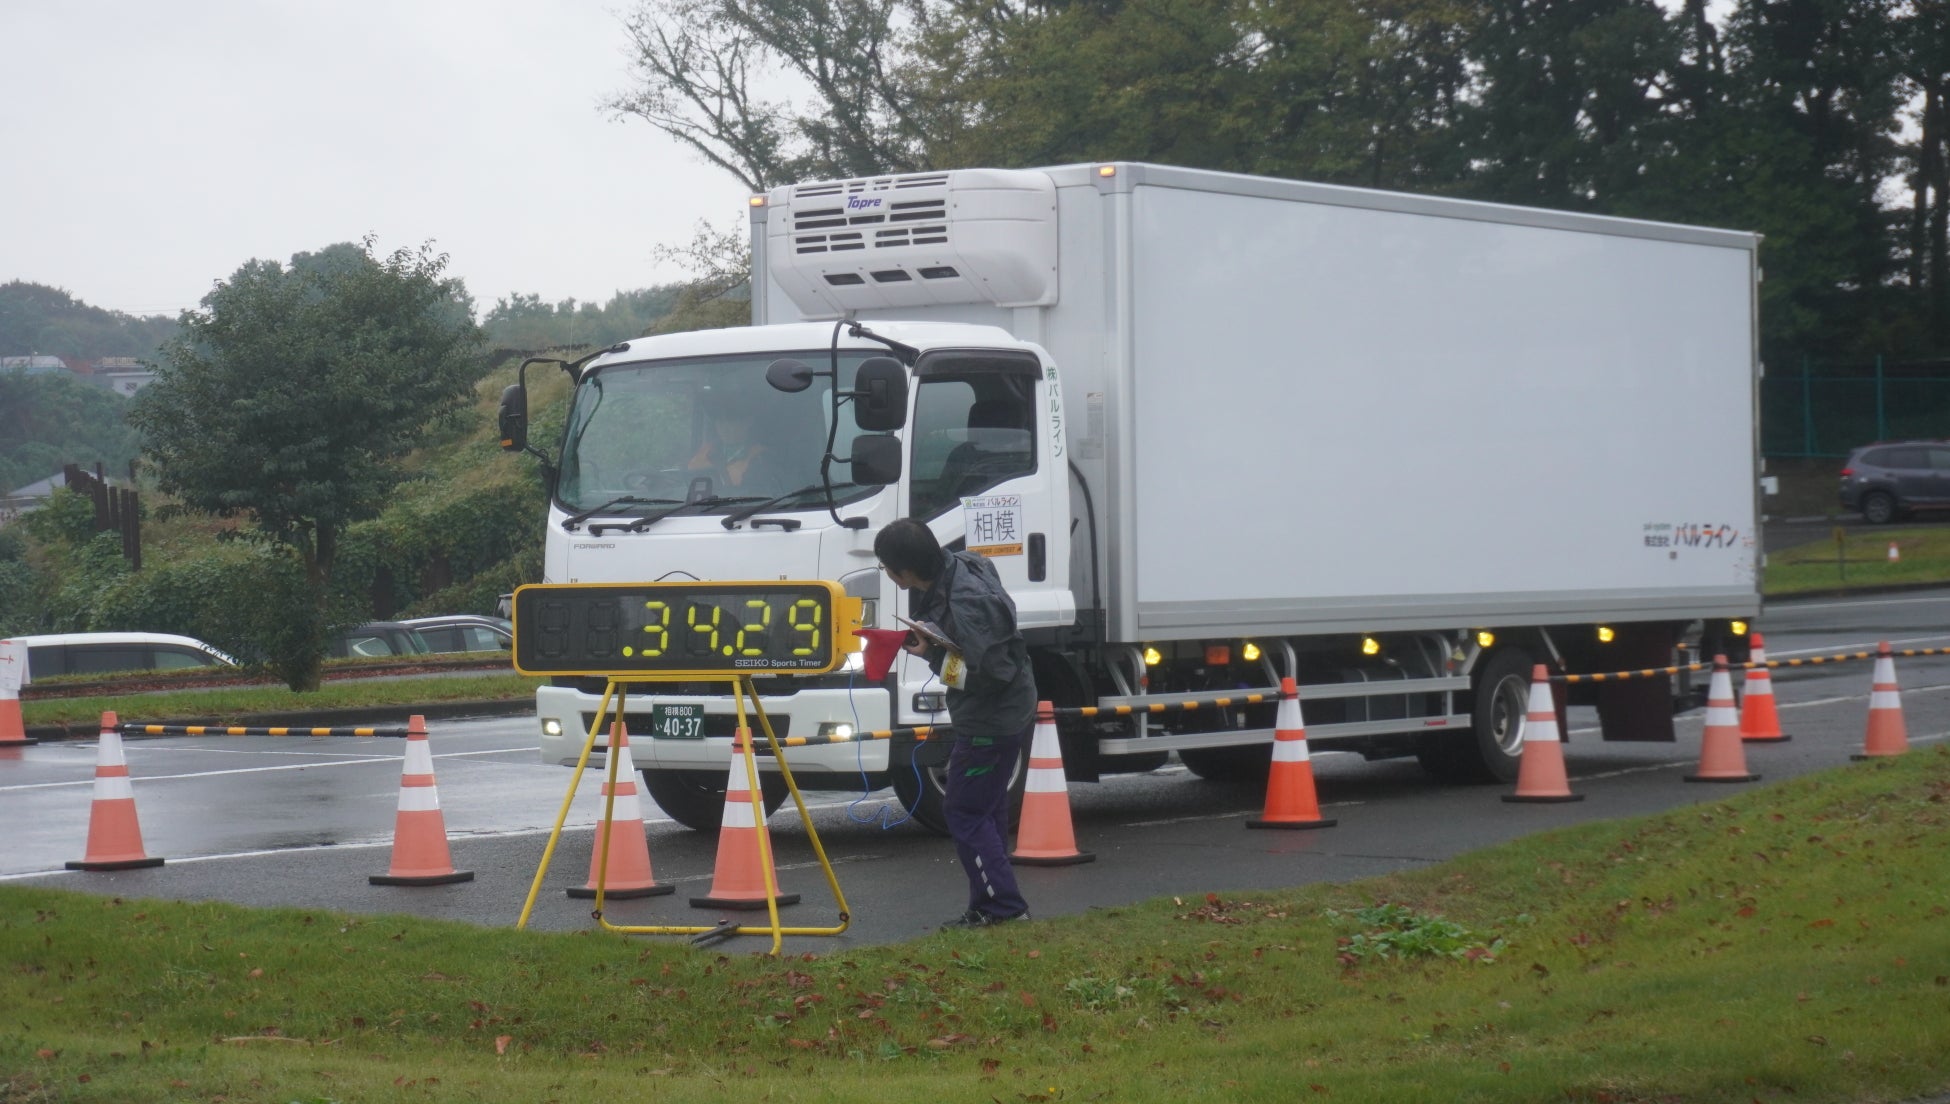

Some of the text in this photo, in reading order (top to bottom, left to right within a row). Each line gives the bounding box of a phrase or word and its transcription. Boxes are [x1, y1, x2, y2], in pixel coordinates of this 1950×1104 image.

[848, 195, 882, 211] Topre
[973, 509, 1016, 543] 相模
[734, 659, 821, 668] SEIKO Sports Timer
[663, 717, 702, 736] 40-37
